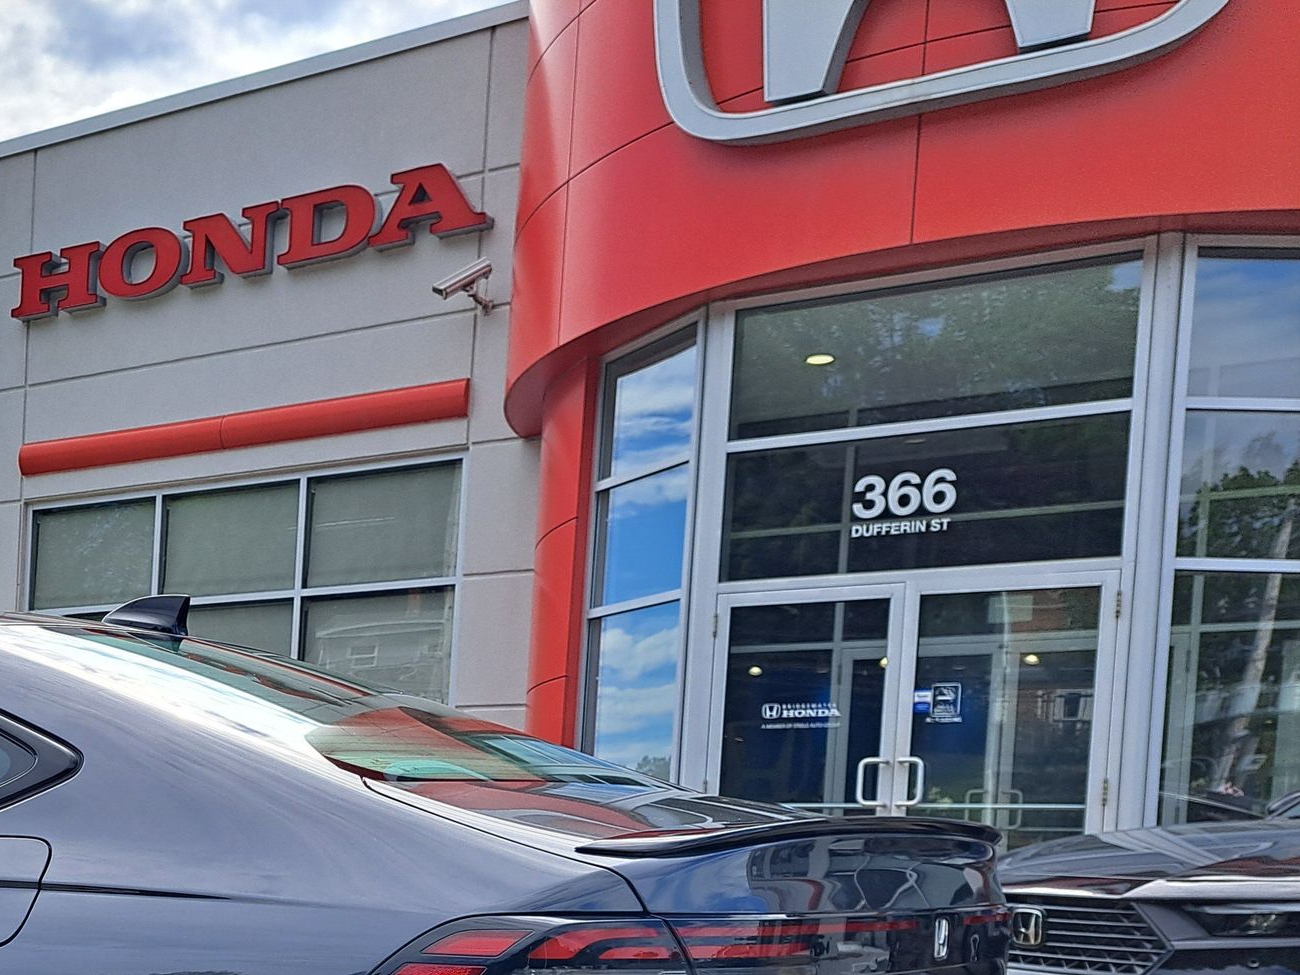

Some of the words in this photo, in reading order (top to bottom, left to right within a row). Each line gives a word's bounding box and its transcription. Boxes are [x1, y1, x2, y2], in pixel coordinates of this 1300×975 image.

[11, 163, 491, 320] HONDA
[852, 468, 957, 519] 366
[851, 519, 927, 538] DUFFERIN
[929, 518, 951, 532] ST
[781, 709, 842, 718] HONDA
